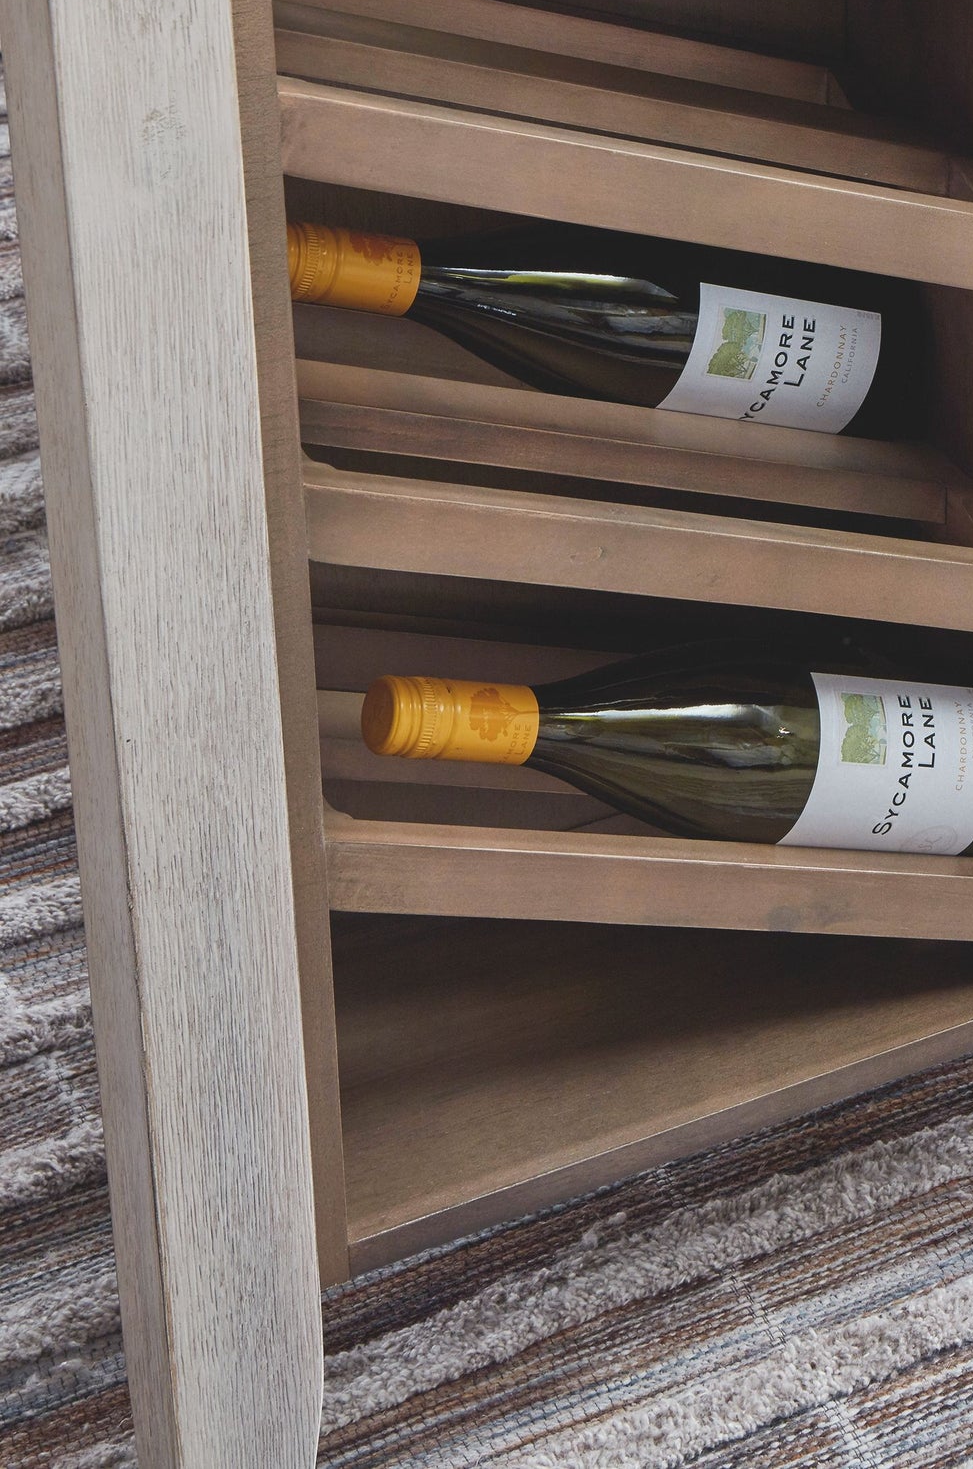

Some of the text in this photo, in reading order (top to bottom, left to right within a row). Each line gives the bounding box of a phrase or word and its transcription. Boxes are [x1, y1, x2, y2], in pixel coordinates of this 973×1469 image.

[403, 252, 414, 284] LANE
[738, 314, 795, 420] YCAMORE
[783, 318, 817, 387] LANE
[816, 324, 847, 408] CHARDONNAY
[841, 327, 858, 384] CALIFORNIA
[514, 724, 532, 755] LANE
[871, 694, 915, 836] SYCAMORE
[917, 696, 936, 769] LANE
[955, 701, 968, 791] CHARDONNAY
